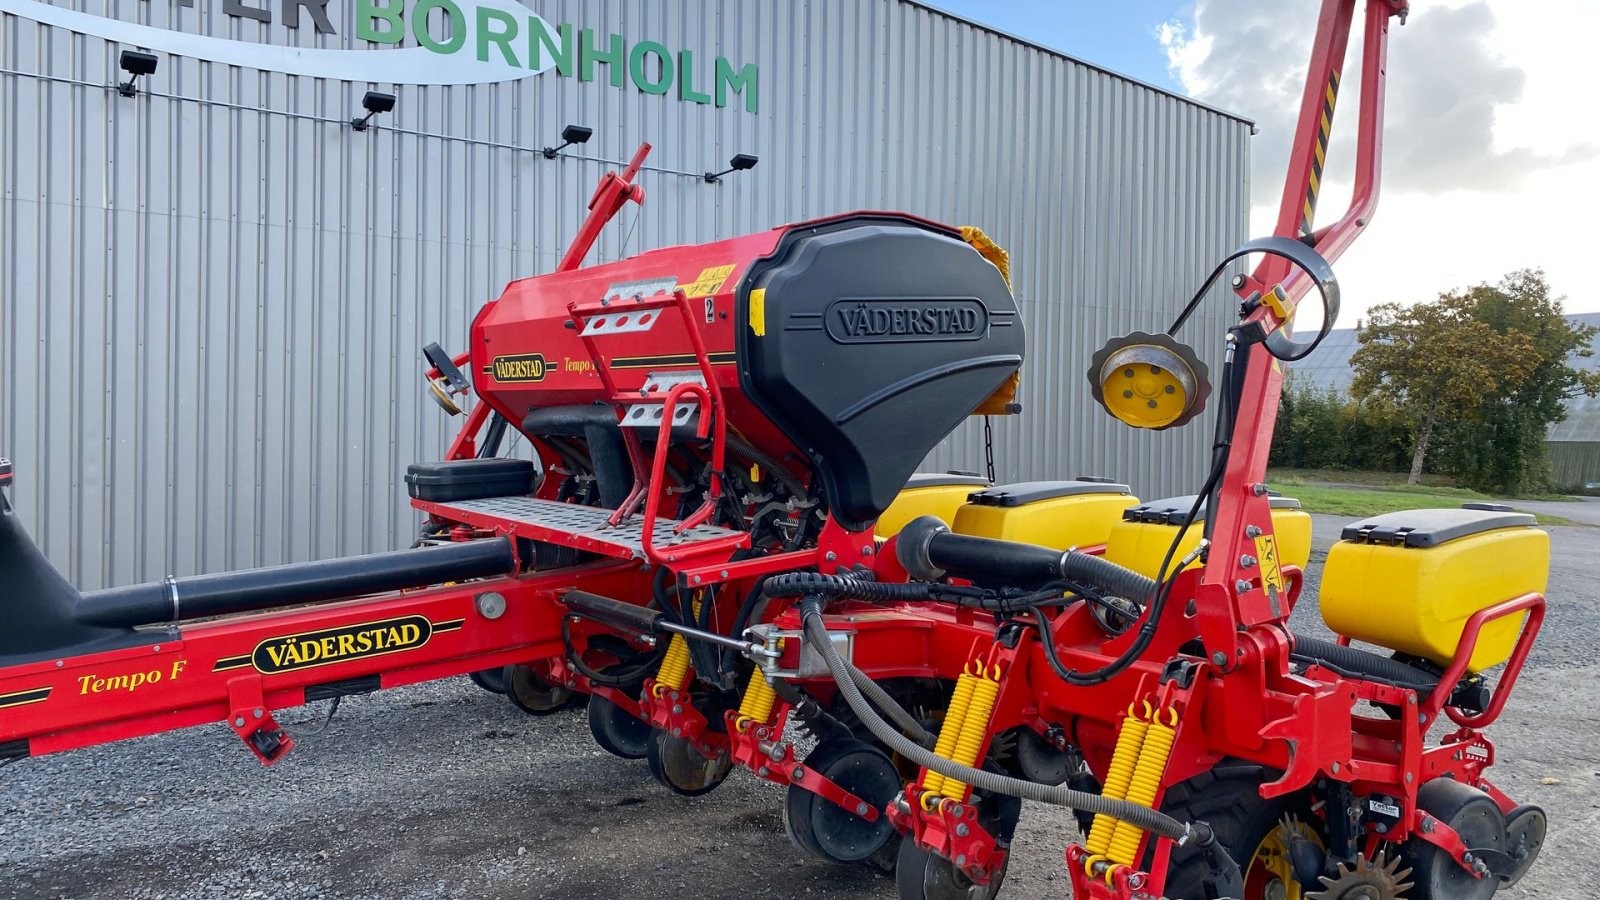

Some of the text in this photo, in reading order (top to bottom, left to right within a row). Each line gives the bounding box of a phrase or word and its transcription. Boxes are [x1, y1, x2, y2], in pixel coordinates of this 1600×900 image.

[356, 0, 758, 113] BORNHOLM
[706, 299, 713, 318] 2
[838, 303, 978, 336] VÄDERSTAD
[495, 358, 542, 378] VÄDERSTAD
[564, 357, 590, 375] Tempo
[266, 623, 420, 667] VÄDERSTAD
[77, 660, 187, 695] Tempo F
